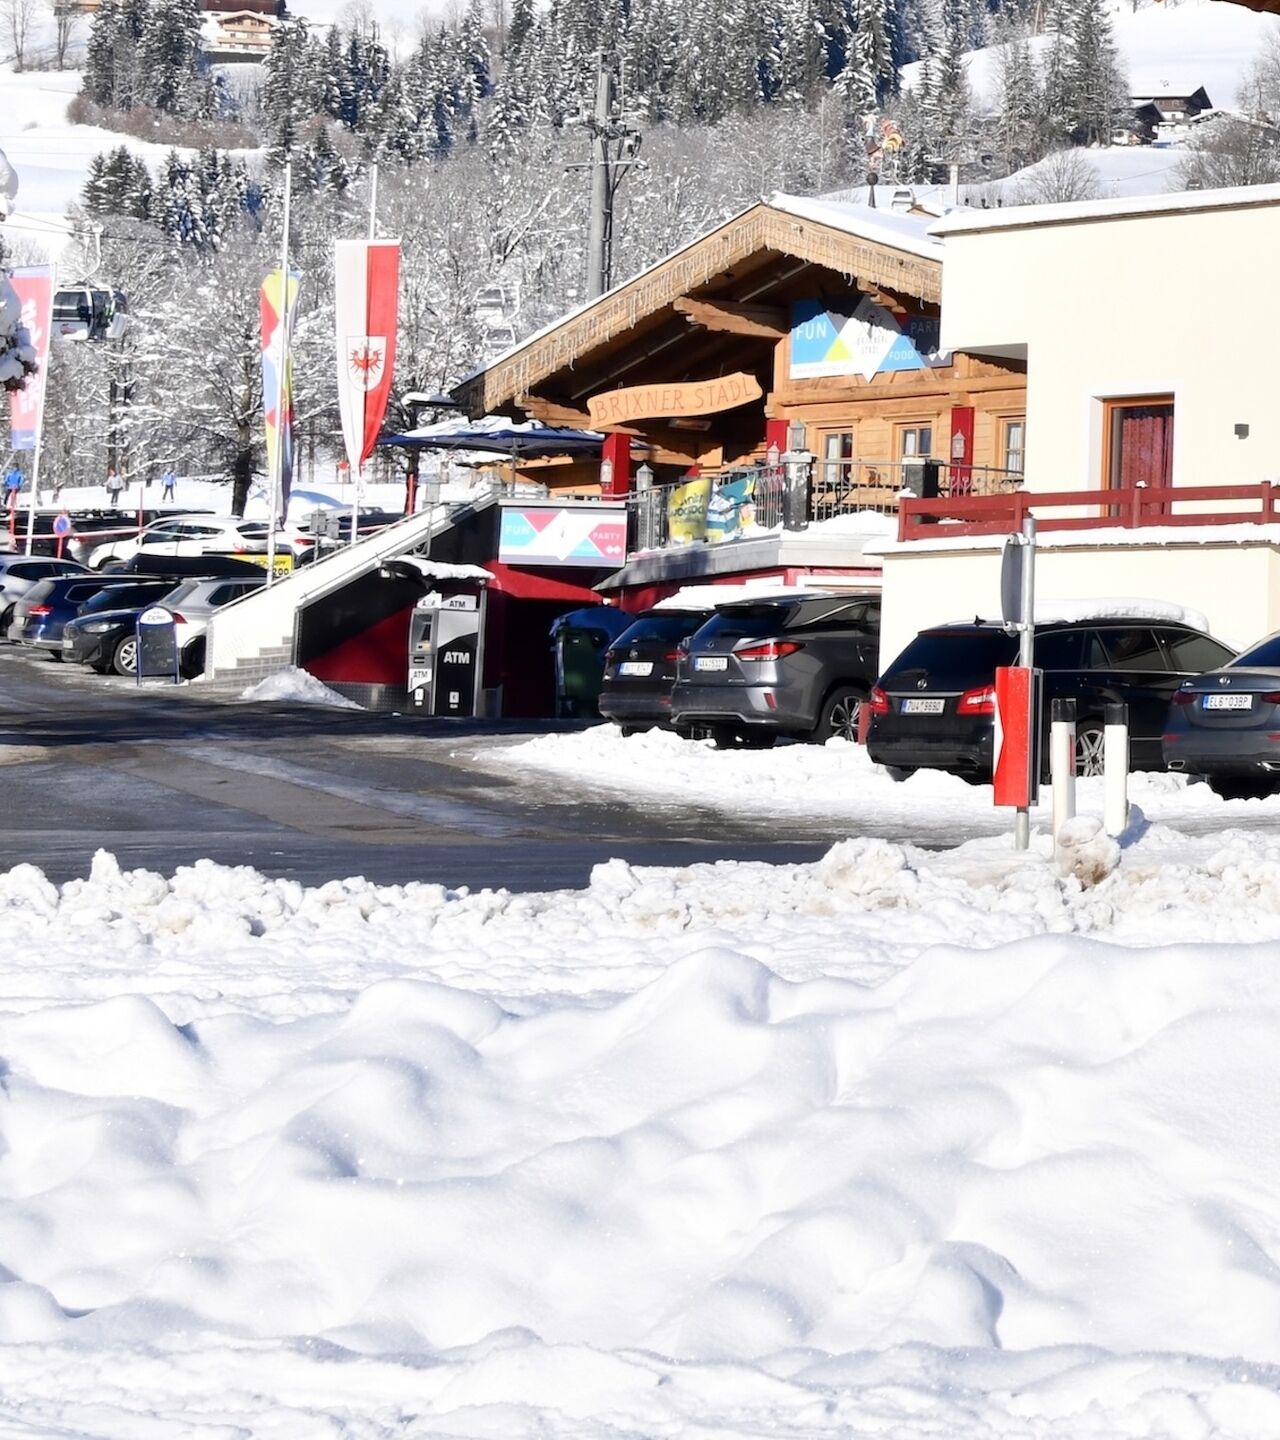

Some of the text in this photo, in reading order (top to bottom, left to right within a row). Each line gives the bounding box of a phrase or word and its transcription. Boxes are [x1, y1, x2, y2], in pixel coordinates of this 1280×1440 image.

[796, 321, 827, 340] FUN
[888, 350, 914, 361] FOOD
[594, 376, 754, 423] BRIXNER STADL
[504, 525, 530, 536] FUN
[592, 531, 621, 541] PARTY
[448, 600, 466, 608] ATM
[443, 651, 471, 665] ATM
[413, 670, 428, 679] ATM
